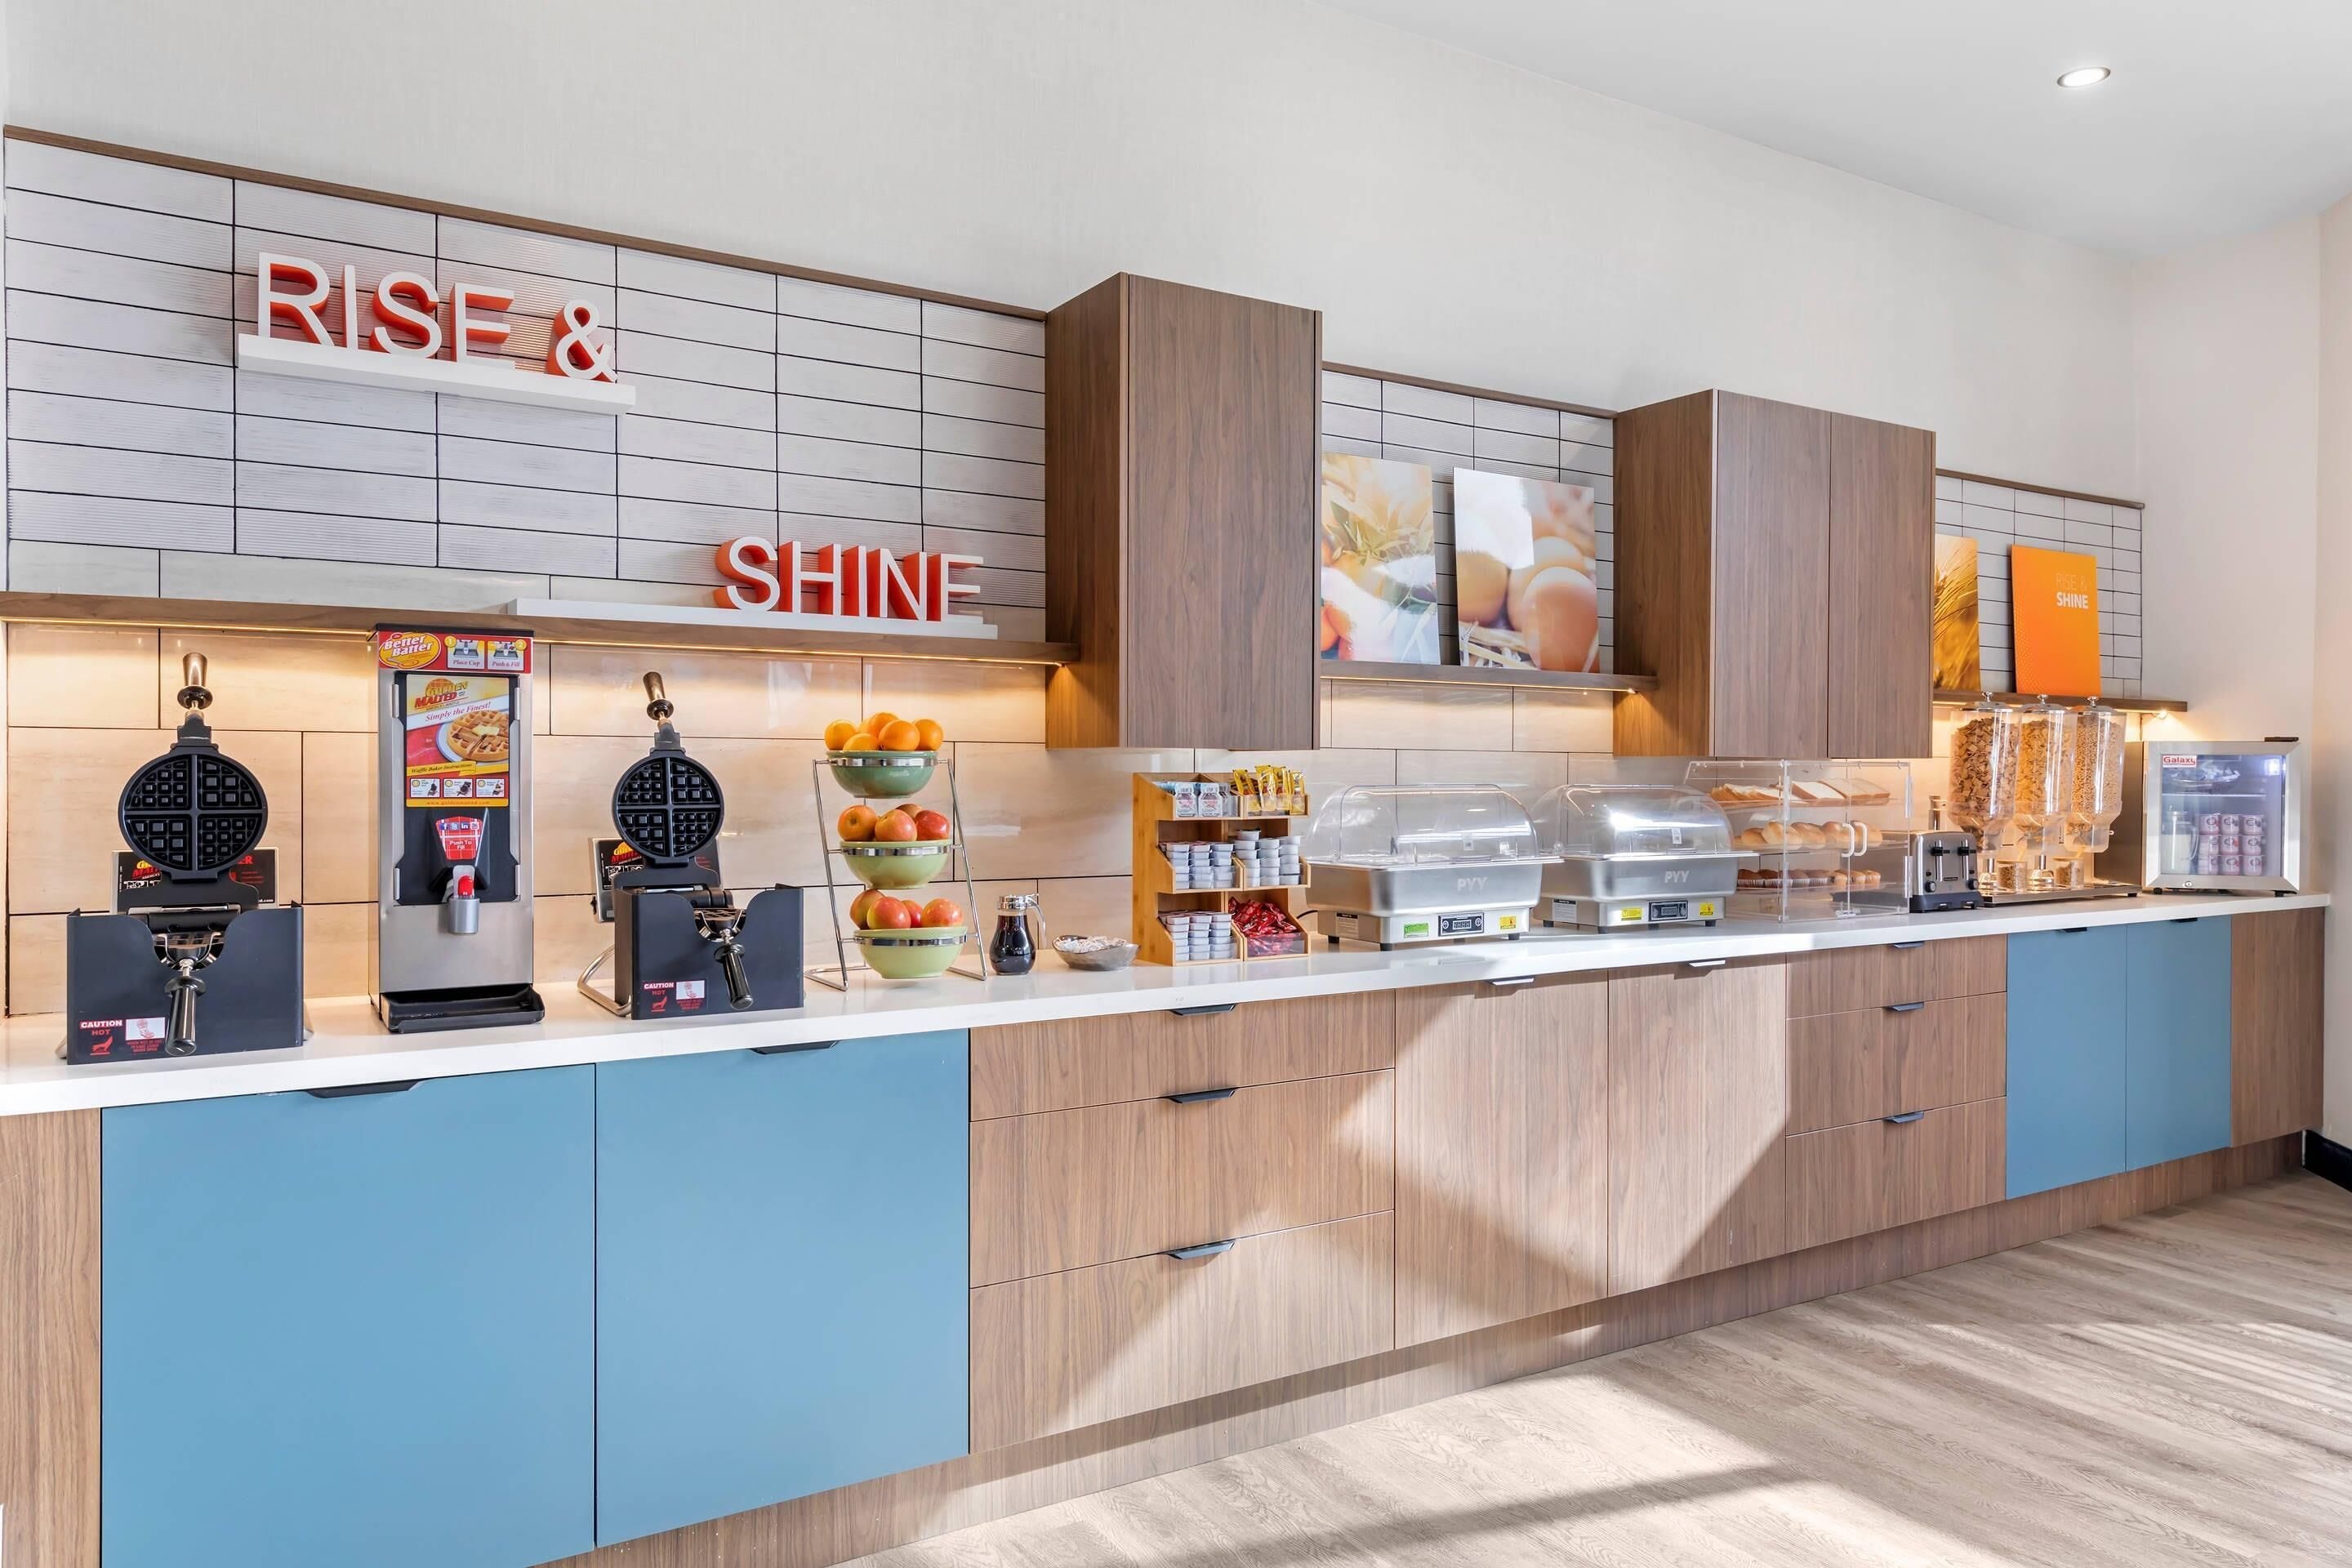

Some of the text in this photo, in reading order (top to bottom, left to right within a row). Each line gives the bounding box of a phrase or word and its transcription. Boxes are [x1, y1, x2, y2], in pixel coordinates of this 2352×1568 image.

[257, 252, 619, 382] RISE &
[713, 536, 984, 623] SHINE
[2056, 572, 2087, 590] RISE &
[2056, 592, 2088, 609] SHINE
[384, 635, 425, 650] Better
[392, 642, 433, 657] Batter
[414, 691, 458, 708] MALTED
[425, 711, 452, 722] Simply
[466, 702, 491, 713] Finest!
[2163, 756, 2196, 765] Galaxy
[644, 982, 675, 990] CAUTION
[80, 1019, 122, 1028] CAUTION
